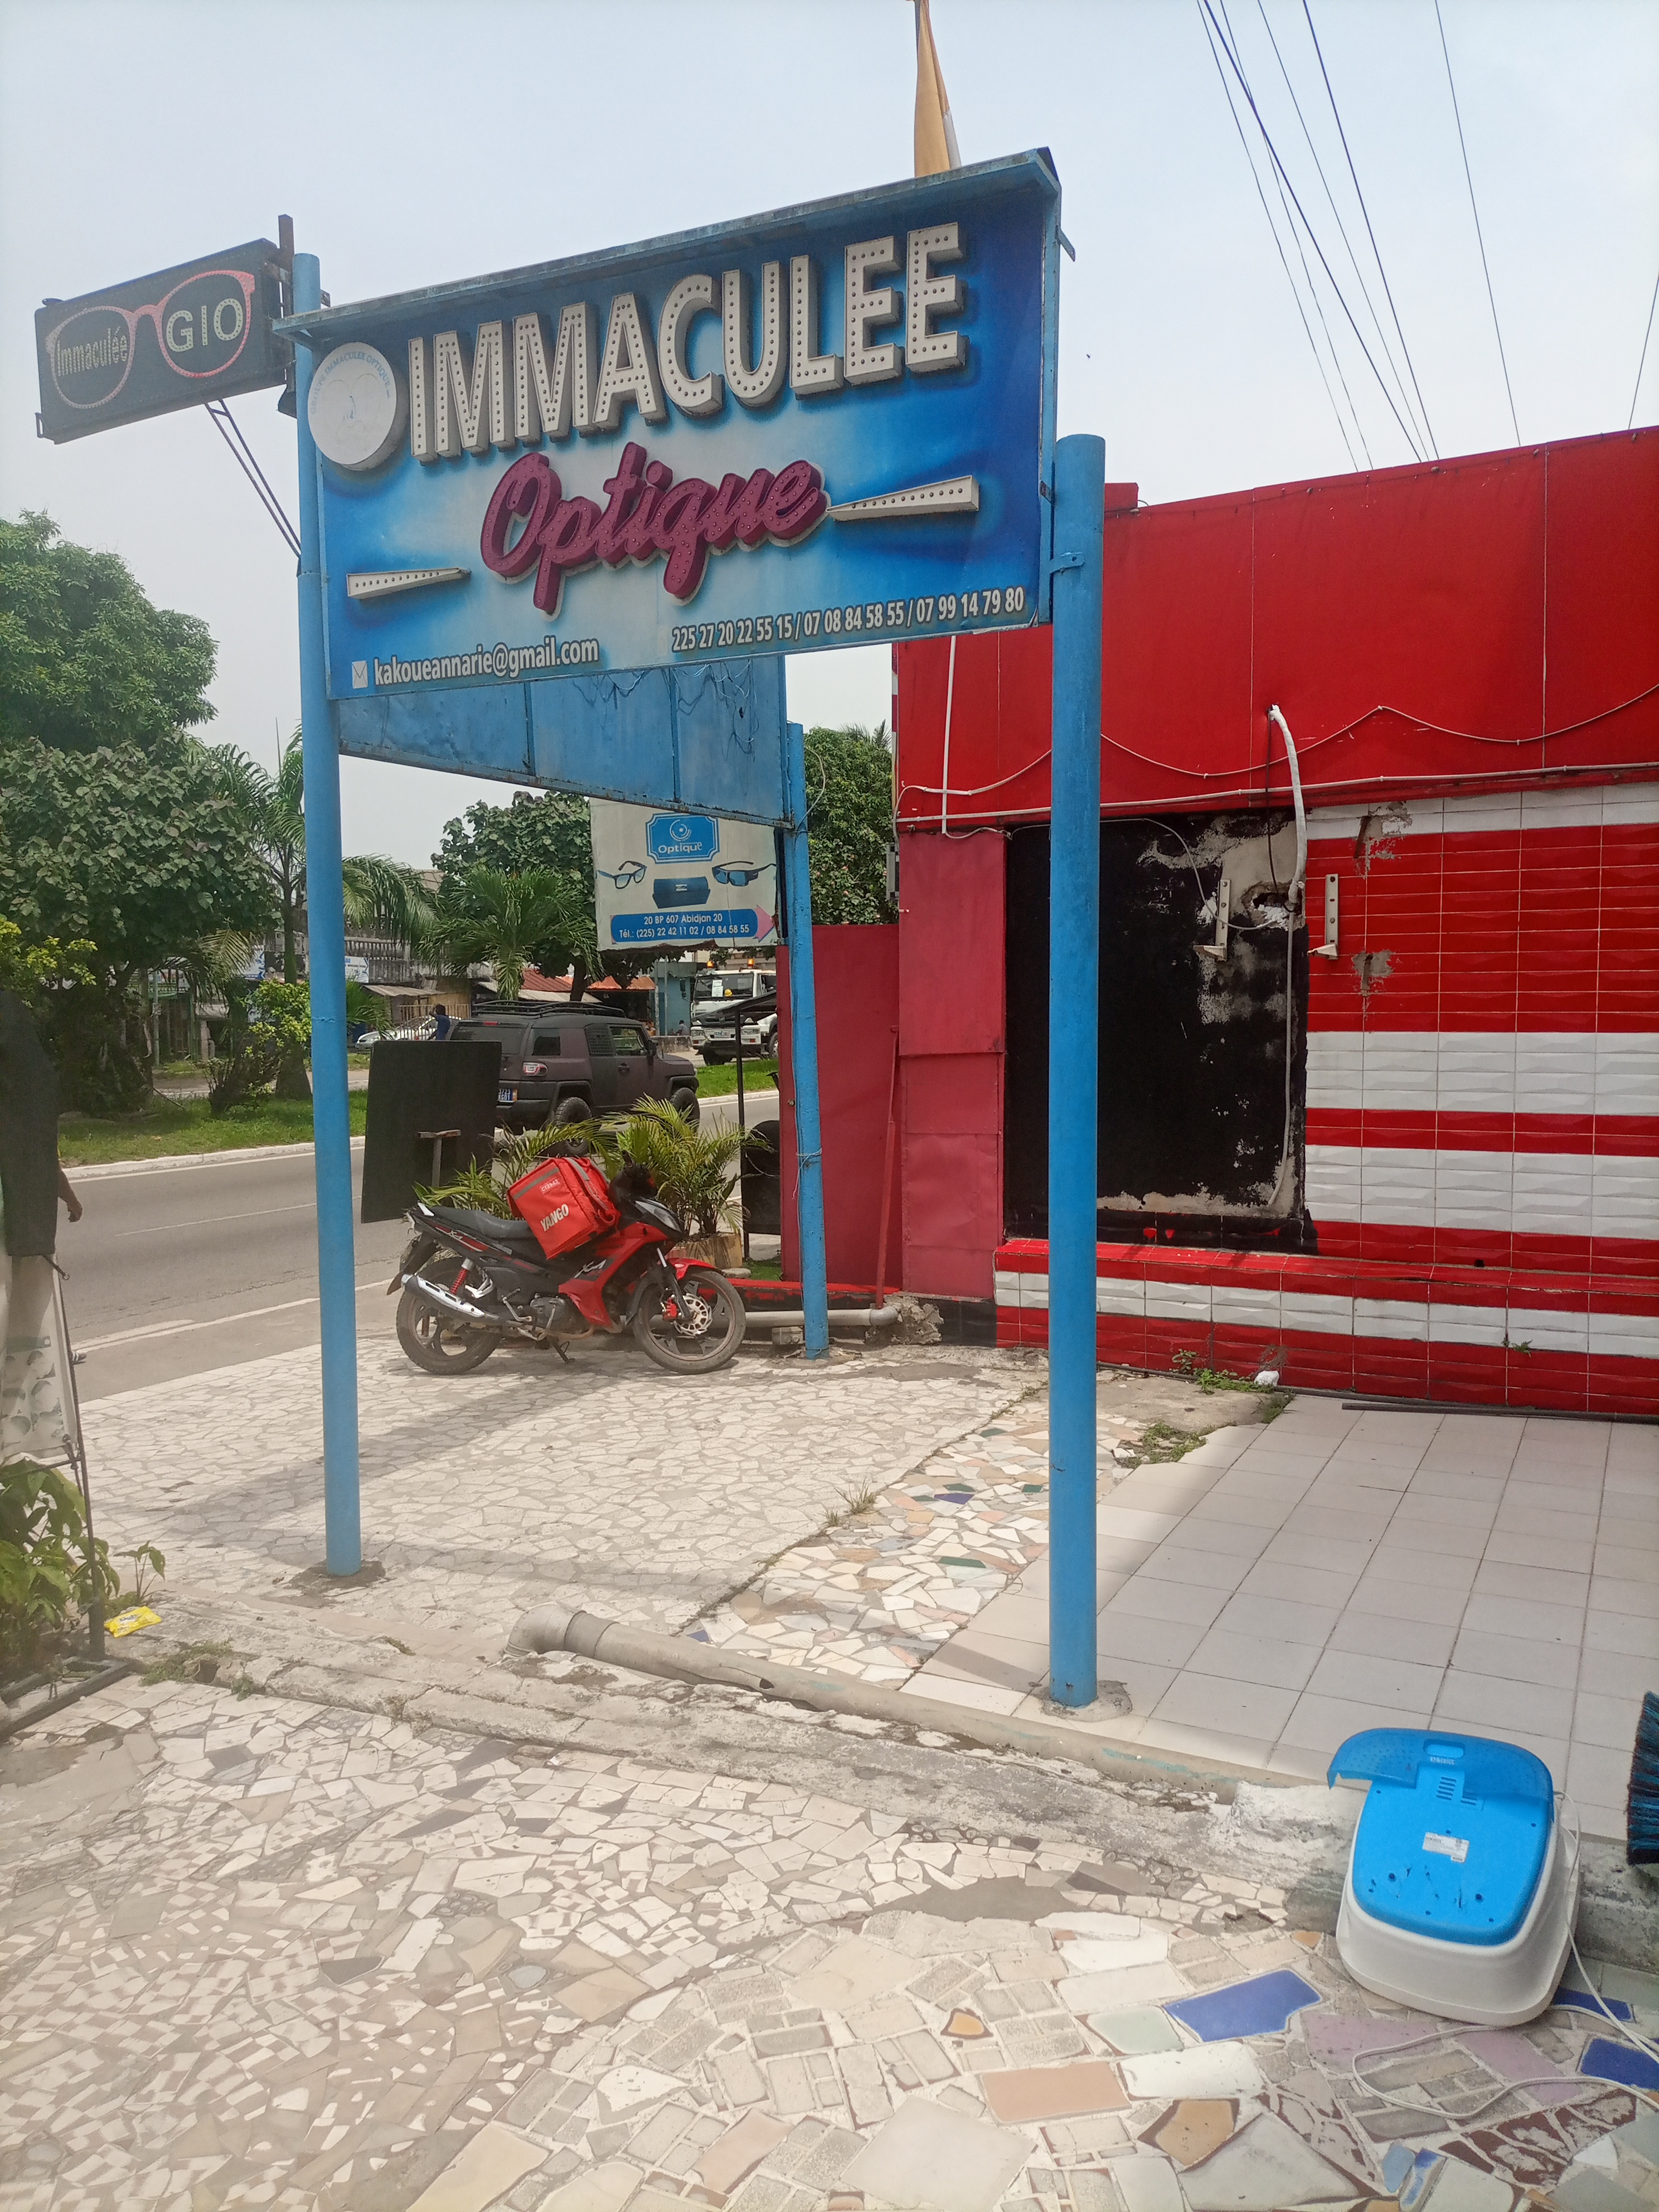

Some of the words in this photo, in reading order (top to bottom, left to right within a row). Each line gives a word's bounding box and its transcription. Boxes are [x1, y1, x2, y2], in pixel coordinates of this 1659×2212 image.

[57, 326, 128, 377] Immaculée
[167, 298, 243, 352] GIO
[408, 222, 964, 462] IMMACULEE
[481, 442, 825, 613] Optique
[673, 627, 696, 651] 225
[699, 624, 714, 648] 27
[718, 621, 734, 646] 20
[737, 619, 753, 644] 22
[756, 617, 773, 641] 55
[777, 615, 793, 639] 15
[804, 612, 820, 636] 07
[824, 609, 841, 633] 08
[845, 607, 862, 630] 84
[866, 604, 883, 628] 58
[887, 601, 904, 626] 55
[916, 598, 934, 622] 07
[938, 595, 956, 620] 99
[961, 592, 978, 617] 14
[982, 589, 1001, 615] 79
[1005, 586, 1024, 612] 80
[373, 636, 599, 686] kakoueannarie@gmail.com
[658, 841, 702, 854] Optique
[636, 928, 654, 938] (225)
[657, 927, 666, 936] 22
[668, 926, 677, 935] 42
[679, 926, 686, 935] 11
[689, 926, 698, 935] 02
[706, 926, 715, 934] 08
[717, 925, 727, 934] 84
[729, 925, 738, 933] 58
[740, 924, 749, 933] 55
[644, 916, 653, 925] 20
[655, 915, 664, 924] BP
[666, 915, 678, 924] 607
[681, 913, 711, 924] Abidjan
[714, 913, 722, 921] 20
[540, 1204, 569, 1231] YANGO
